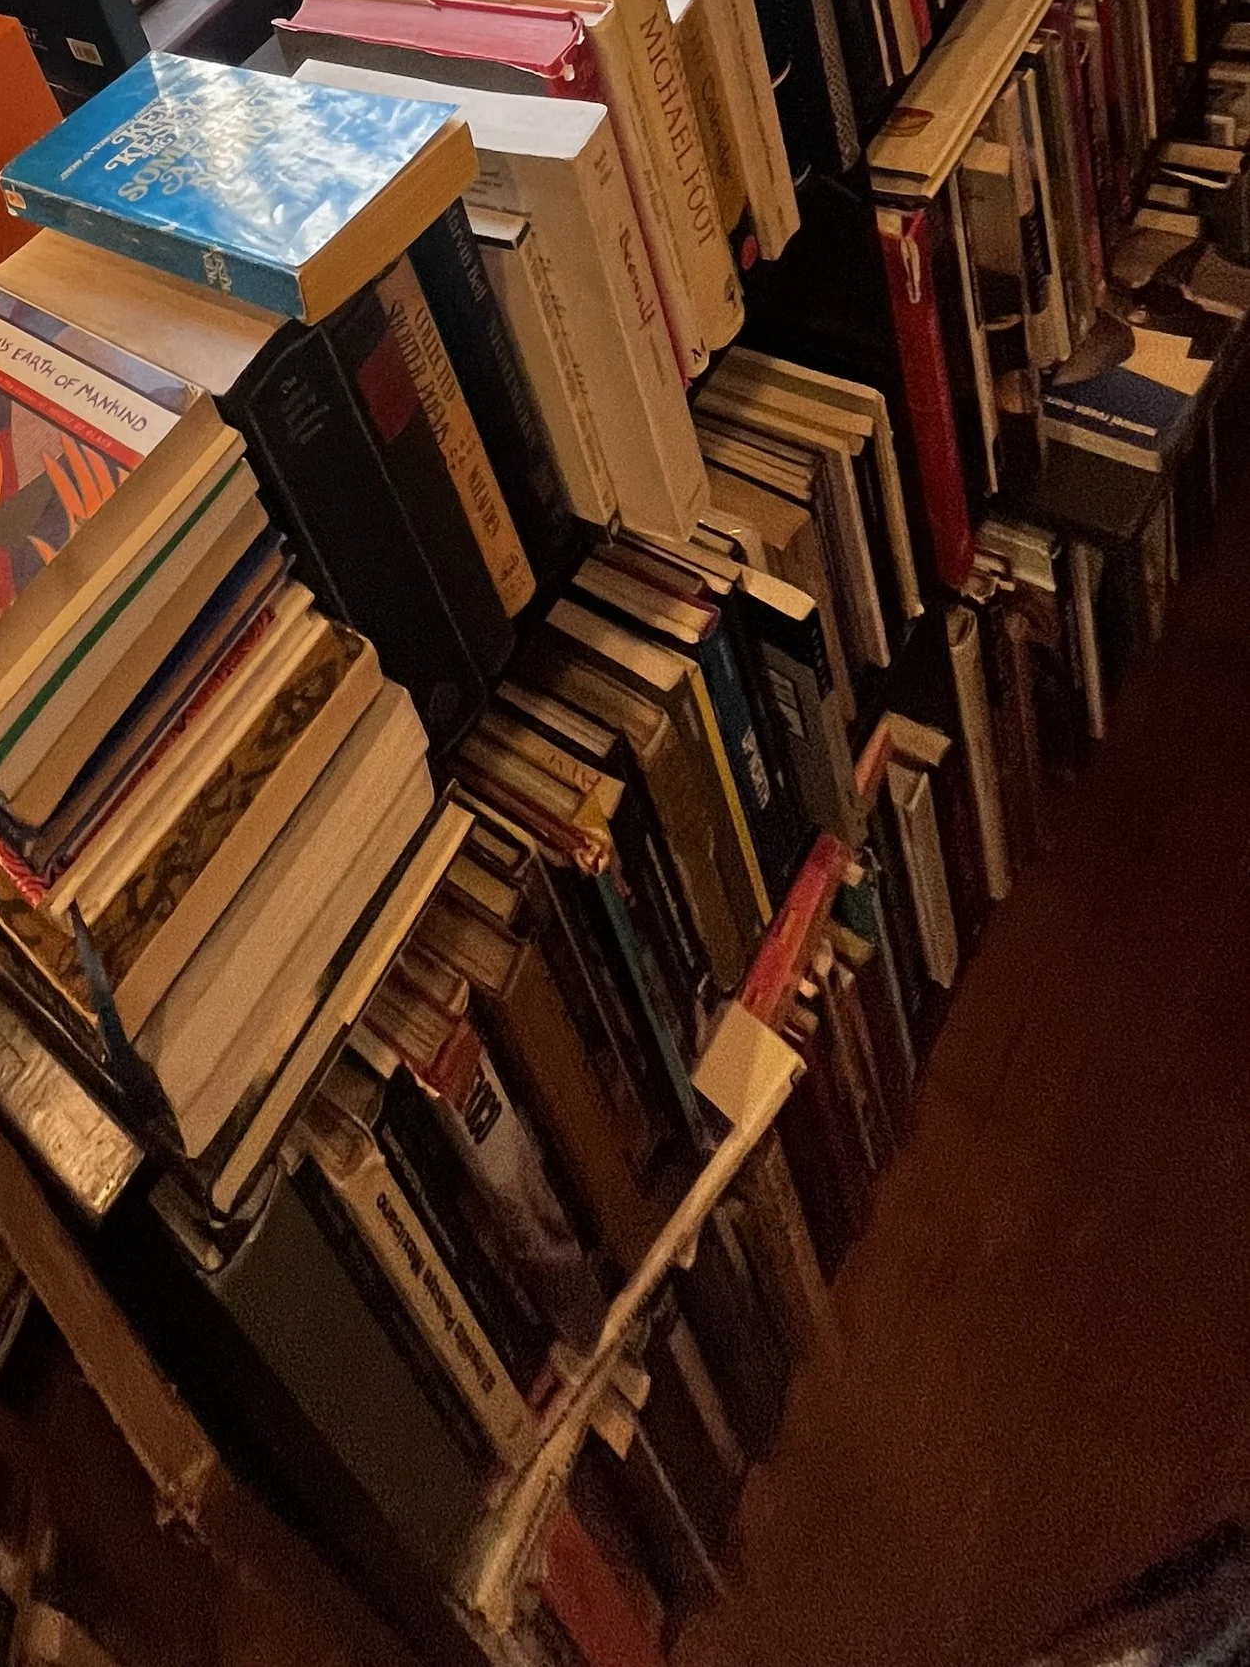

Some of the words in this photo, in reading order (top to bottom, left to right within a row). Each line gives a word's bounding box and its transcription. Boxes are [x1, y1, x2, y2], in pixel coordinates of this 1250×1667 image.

[105, 102, 201, 172] KESEY
[639, 14, 696, 176] MICHAEL
[680, 169, 720, 248] FOOT
[389, 300, 423, 382] SHORTER
[413, 306, 458, 402] COLLECTED
[10, 347, 57, 378] EARTH
[54, 373, 80, 391] OF
[73, 383, 148, 433] MANKIND
